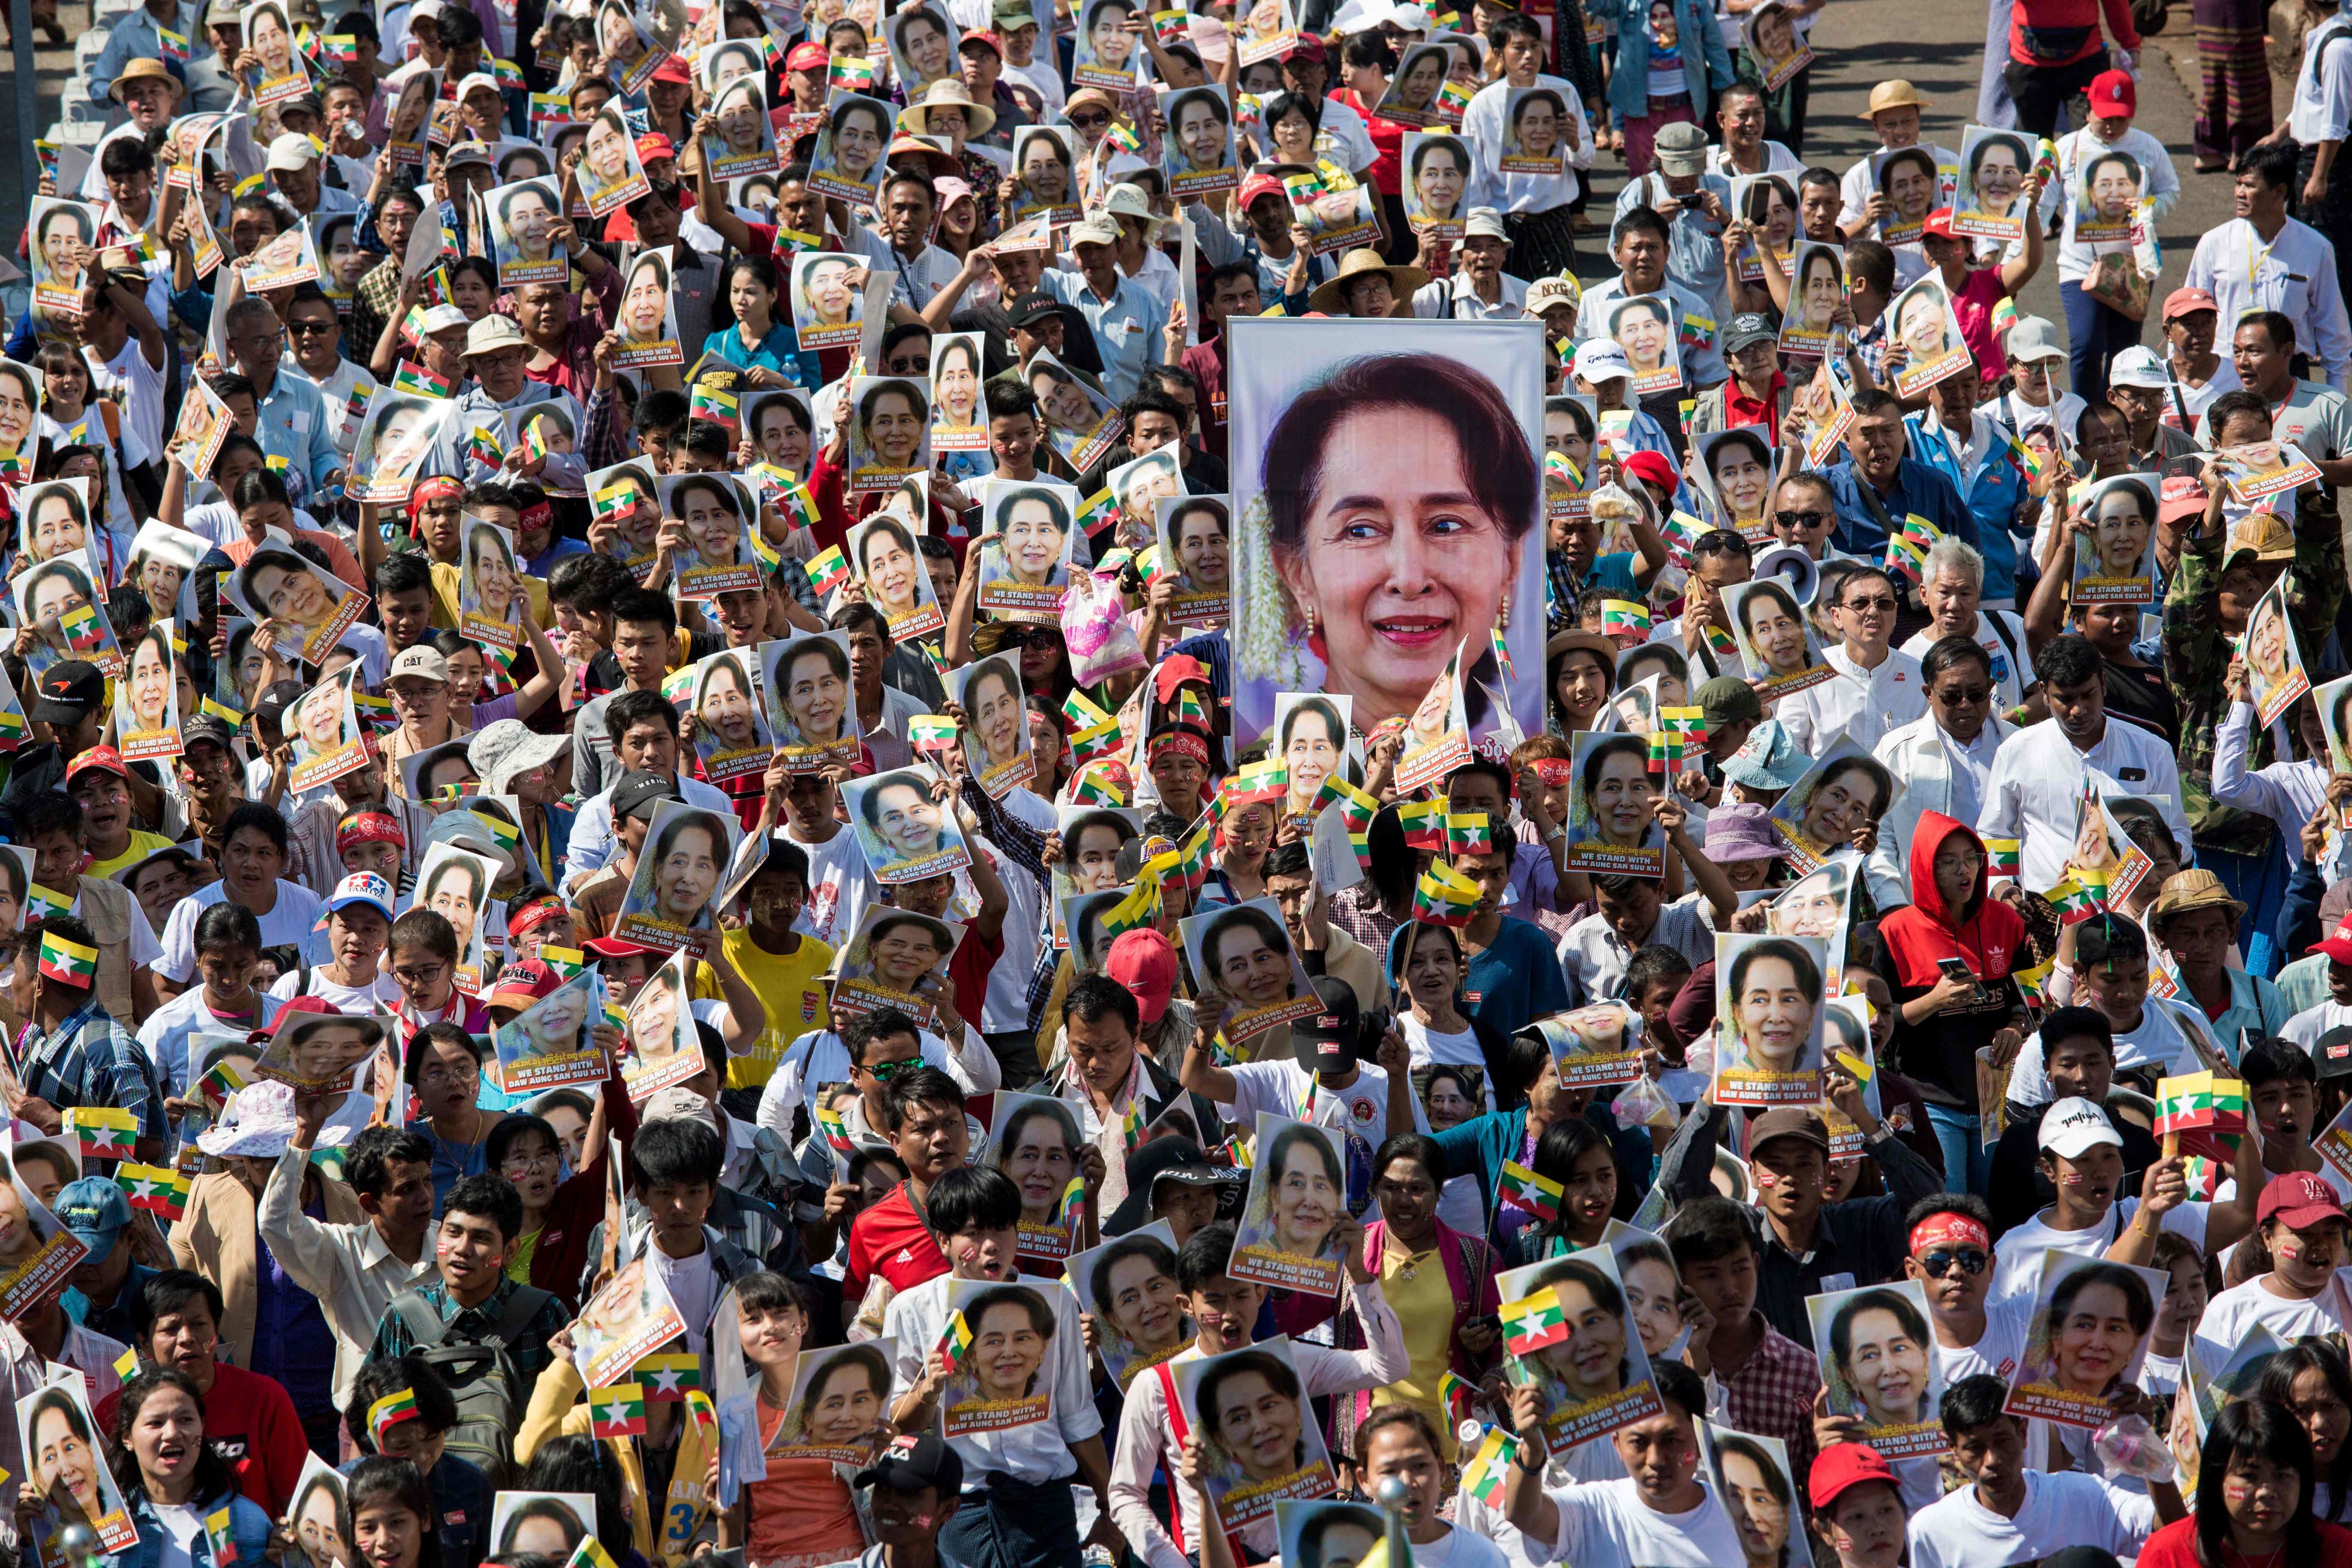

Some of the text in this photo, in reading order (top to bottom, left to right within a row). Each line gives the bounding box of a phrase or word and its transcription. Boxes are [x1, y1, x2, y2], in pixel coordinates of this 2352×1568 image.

[639, 138, 661, 152] NLD
[1587, 354, 1624, 363] TaylorMade
[701, 371, 737, 383] AMSTERDAM
[703, 574, 728, 583] STAND
[1007, 591, 1033, 599] STAND
[403, 656, 422, 667] CAT
[184, 724, 212, 733] adidas
[128, 736, 173, 749] WE STAND WITH
[1144, 843, 1176, 860] LAKERS
[1596, 853, 1625, 862] STAND
[1628, 856, 1650, 864] WITH
[349, 887, 384, 901] TAMIYA
[1236, 1003, 1308, 1030] WE STAND WITH
[1231, 1030, 1249, 1039] DAW
[1249, 1019, 1271, 1030] AUNG
[1271, 1013, 1288, 1021] SAN
[517, 1060, 593, 1078] WE STAND WITH
[508, 1067, 604, 1088] DAW AUNG SAN SUU KYI
[1729, 1081, 1806, 1091] WE STAND WITH
[1719, 1090, 1737, 1098] DAW
[1739, 1091, 1761, 1099] AUNG
[3, 1244, 82, 1316] DAW AUNG SAN SUU KYI
[4, 1245, 68, 1302] WE STAND WITH
[959, 1405, 1036, 1421] WE STAND WITH
[948, 1423, 967, 1431] DAW
[969, 1419, 993, 1429] AUNG
[994, 1417, 1012, 1426] SAN
[1013, 1414, 1028, 1422] SUU
